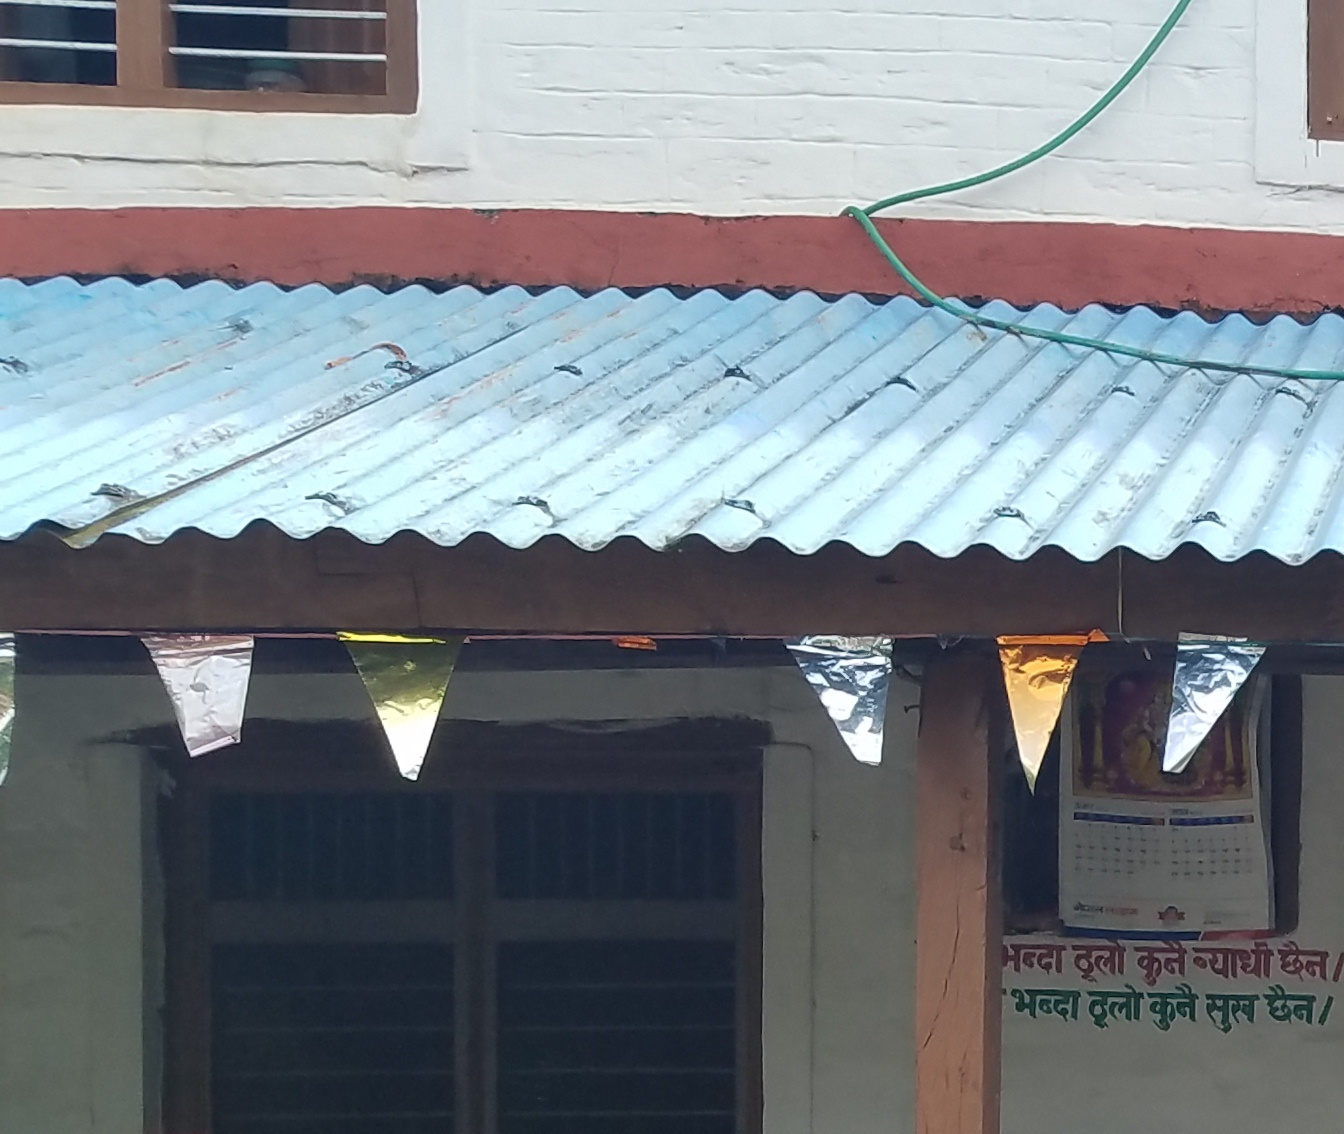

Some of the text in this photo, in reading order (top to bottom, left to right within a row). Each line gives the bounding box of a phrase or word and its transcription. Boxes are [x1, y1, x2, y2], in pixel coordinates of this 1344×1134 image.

[1134, 940, 1187, 986] कुनै
[1011, 987, 1081, 1022] भन्दा
[1147, 983, 1199, 1031] कुनै
[1205, 994, 1260, 1034] सुख
